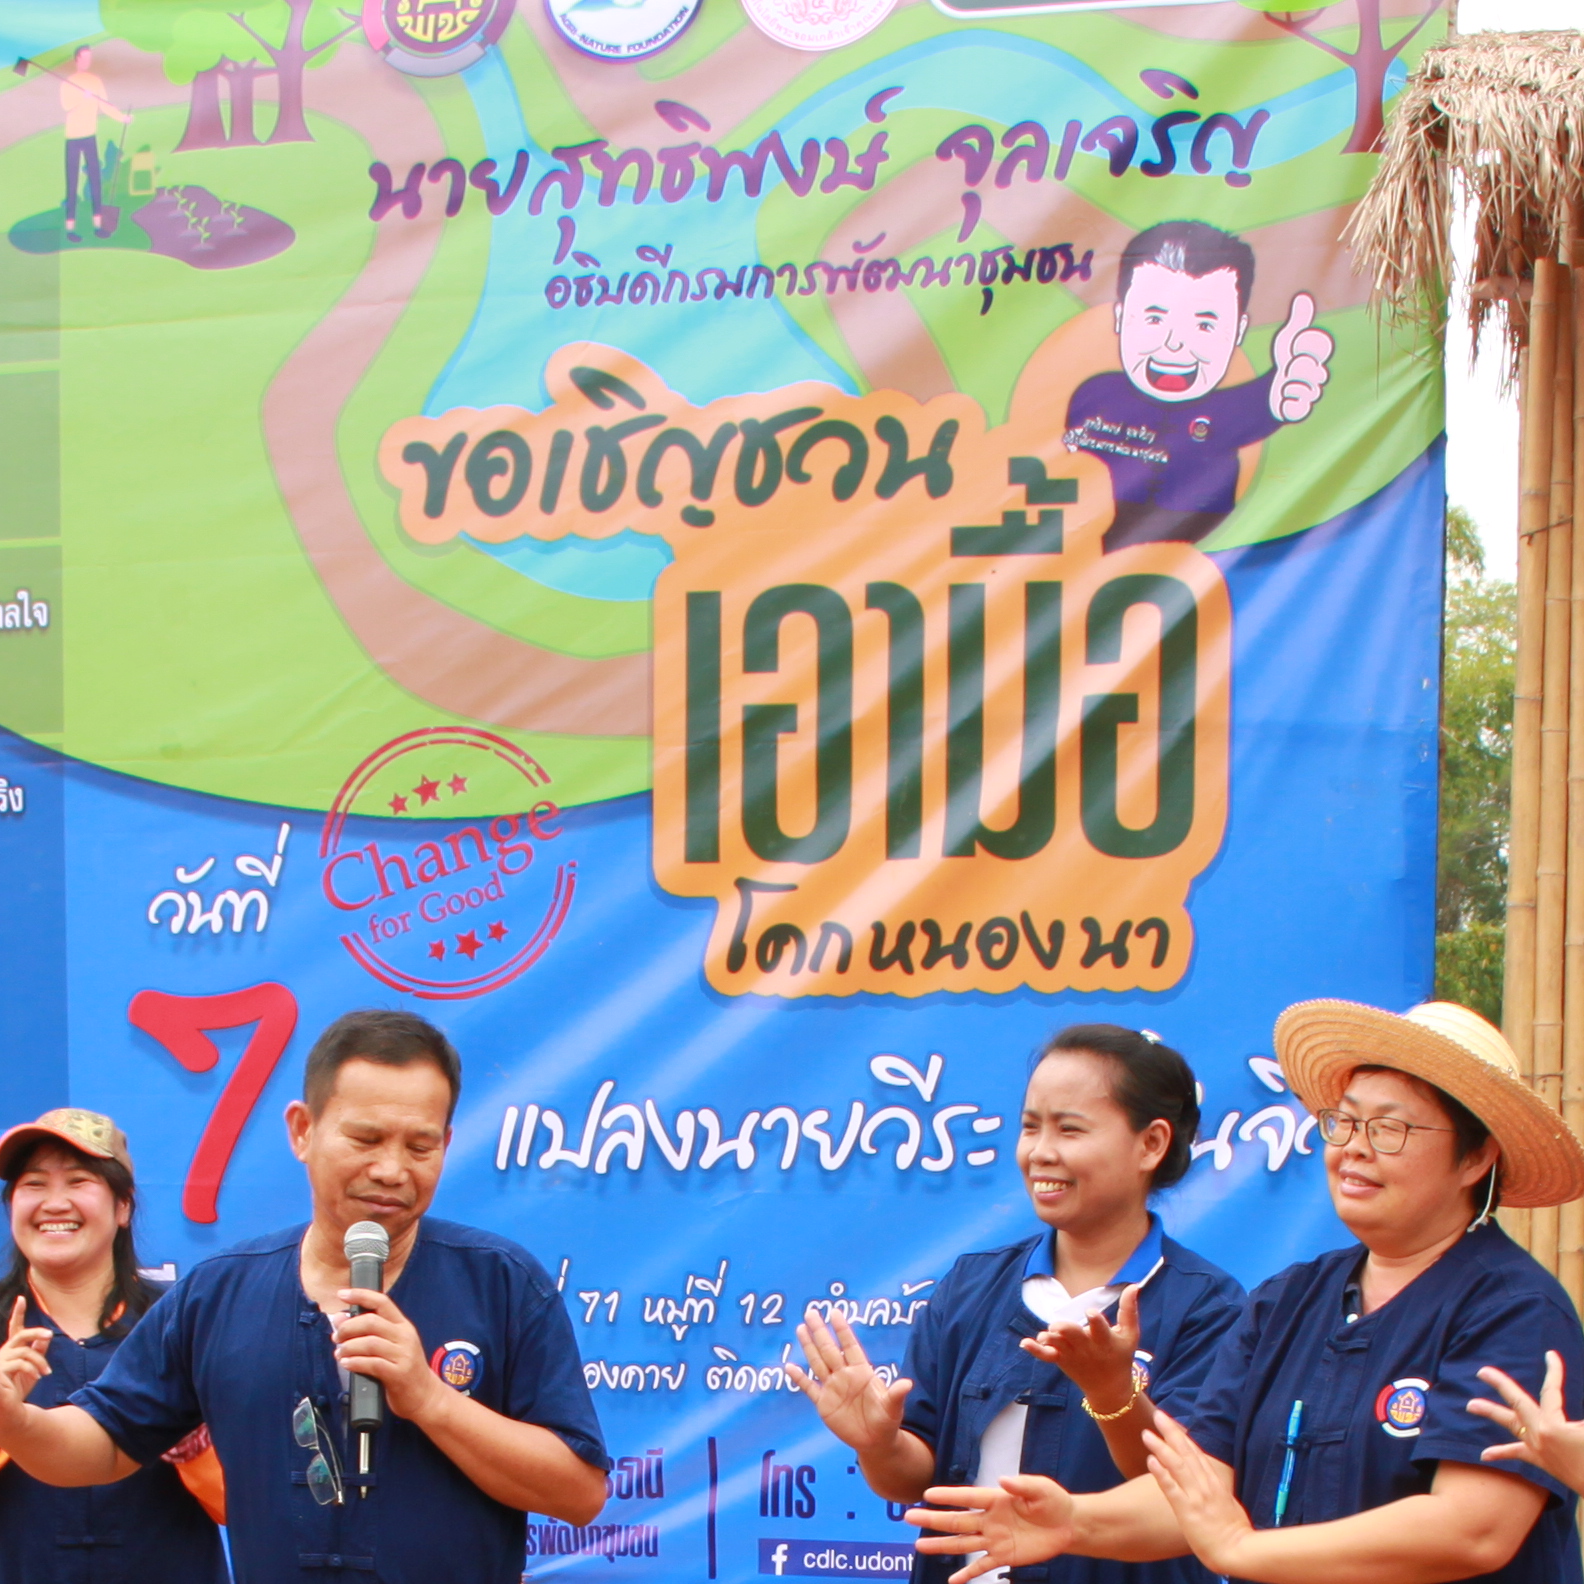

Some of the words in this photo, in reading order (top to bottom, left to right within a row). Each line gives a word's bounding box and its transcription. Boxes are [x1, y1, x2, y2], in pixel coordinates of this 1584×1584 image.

[559, 13, 622, 54] AGRI-NATURE
[626, 5, 689, 54] FOUNDATION
[369, 86, 905, 262] นายสุทธิพงษ์
[935, 68, 1270, 240] จุลเจริญ
[545, 243, 1094, 316] อธิบดีกรมการพัฒนาชุมชน
[401, 366, 960, 526] ขอเชิญชวน
[684, 455, 1201, 866] เอามื้อ
[148, 822, 290, 934] วันที่
[322, 799, 564, 911] Change
[369, 910, 412, 943] for
[419, 873, 505, 923] Good
[128, 981, 299, 1225] 7
[495, 1054, 999, 1173] แปลงนายวีระ
[580, 1292, 619, 1324] 71
[644, 1260, 727, 1341] หมู่ที่
[739, 1293, 783, 1324] 12
[759, 1449, 816, 1519] โทร
[803, 1549, 914, 1573] cdlc.udont
